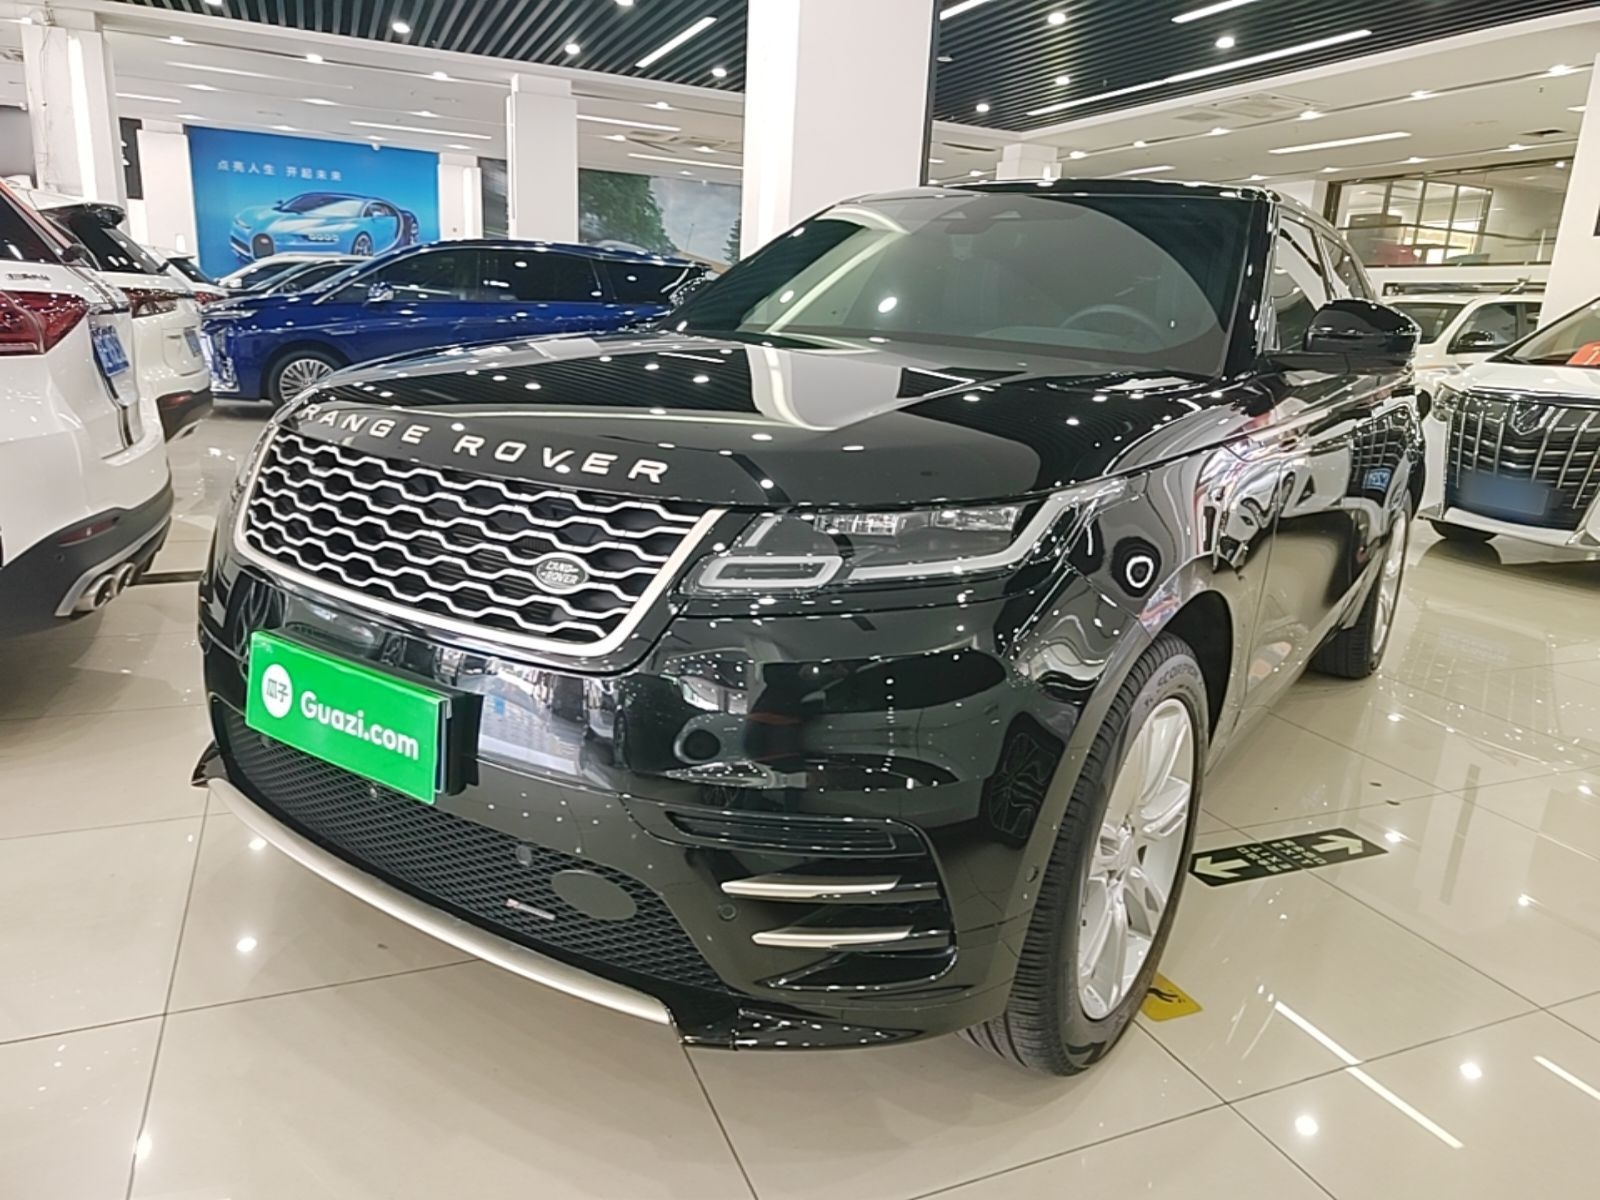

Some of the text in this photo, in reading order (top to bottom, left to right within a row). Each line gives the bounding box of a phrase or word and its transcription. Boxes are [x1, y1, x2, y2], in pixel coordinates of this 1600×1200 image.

[217, 160, 276, 176] 点亮人生
[301, 403, 668, 484] RANGE ROVER
[546, 561, 578, 573] LAND
[543, 570, 579, 585] ROVER
[266, 678, 289, 703] 瓜子
[300, 690, 420, 761] Guazi.com
